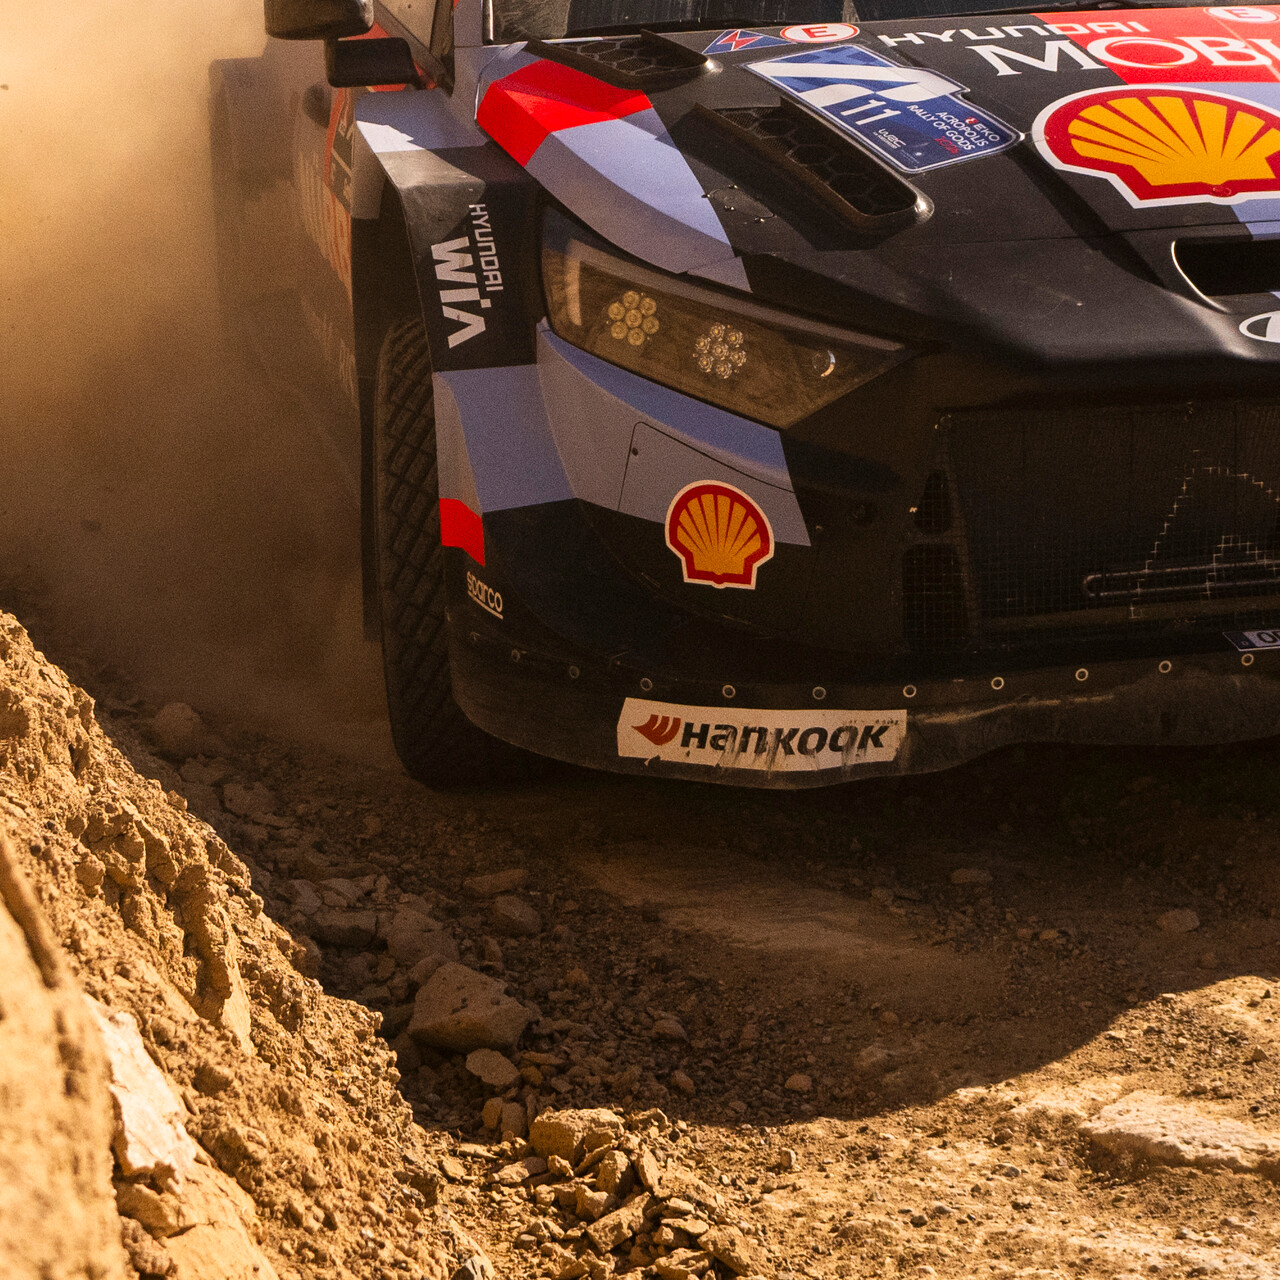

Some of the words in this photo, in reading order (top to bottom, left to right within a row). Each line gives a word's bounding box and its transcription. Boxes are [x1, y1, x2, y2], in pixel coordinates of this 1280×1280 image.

[801, 26, 838, 39] E
[877, 21, 1150, 47] HYUNDAI
[840, 99, 902, 126] 11
[878, 128, 907, 148] WRC
[907, 104, 938, 121] RALLY
[933, 121, 951, 132] OF
[945, 130, 975, 151] GODS
[935, 112, 989, 147] ACROPOLIS
[973, 123, 1000, 142] EKO
[469, 203, 504, 291] HYUNDAI
[467, 571, 502, 613] sparco
